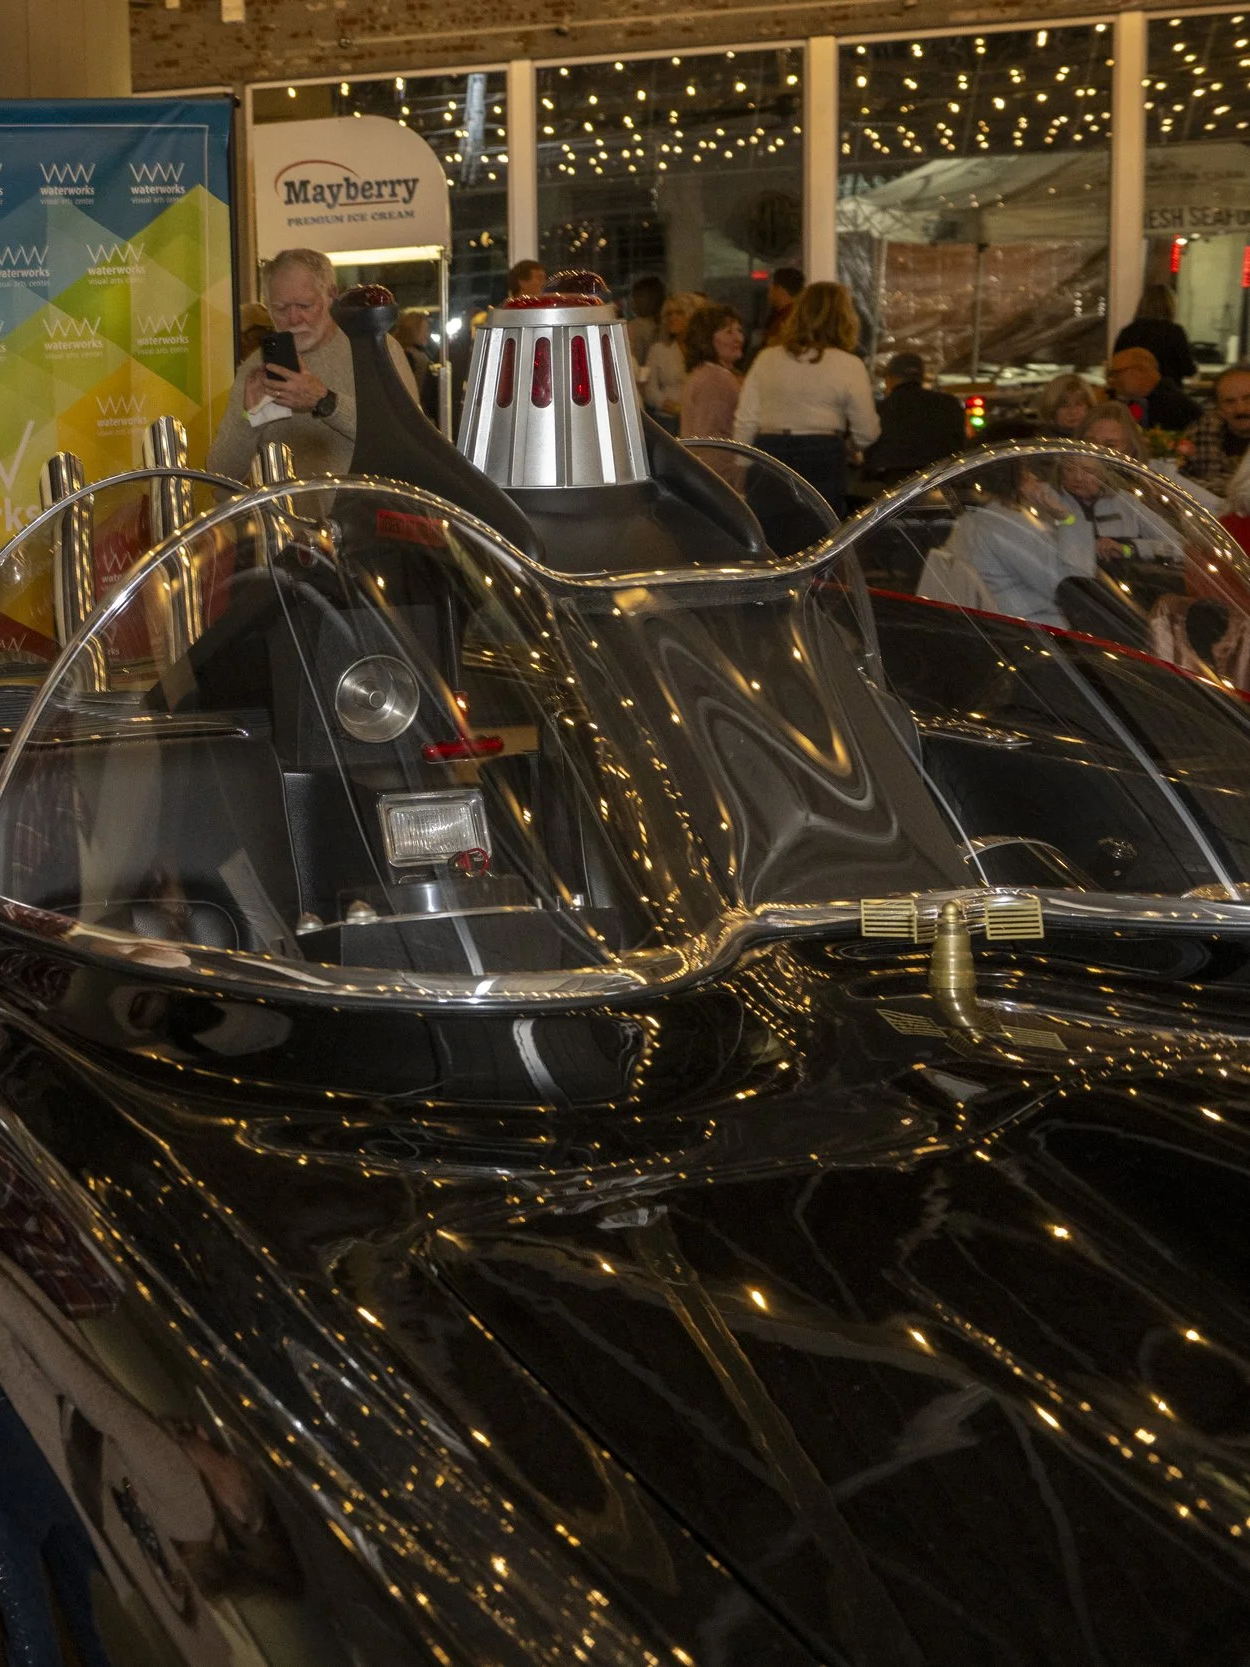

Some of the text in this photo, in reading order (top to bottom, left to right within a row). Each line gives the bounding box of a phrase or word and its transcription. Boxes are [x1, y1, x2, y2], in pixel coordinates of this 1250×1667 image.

[40, 184, 95, 196] waterworks
[130, 183, 185, 195] waterworks
[284, 176, 419, 209] Mayberry
[287, 210, 415, 227] PREMIUM ICE CREAM
[1145, 207, 1183, 229] ESH
[87, 264, 146, 276] waterworks
[44, 337, 103, 350] waterworks
[136, 334, 189, 346] waterworks
